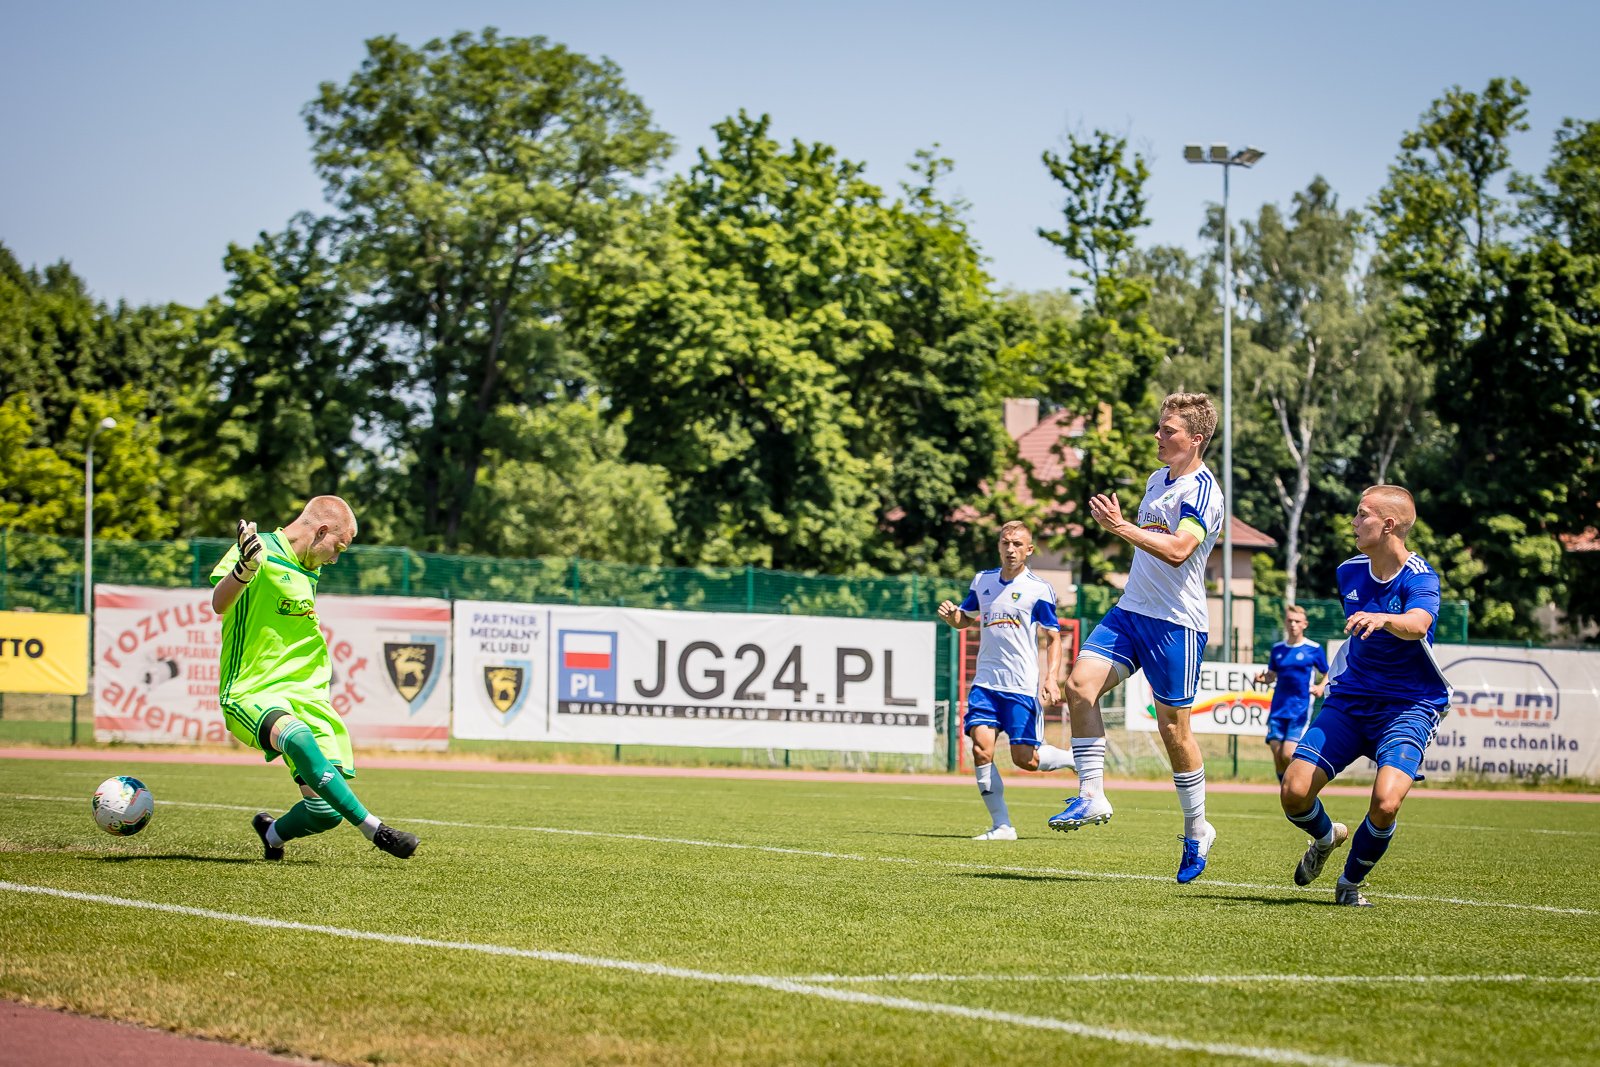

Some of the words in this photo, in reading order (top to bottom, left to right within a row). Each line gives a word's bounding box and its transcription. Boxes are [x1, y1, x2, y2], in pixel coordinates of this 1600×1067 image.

[473, 613, 537, 626] PARTNER
[103, 601, 222, 668] rozrus
[470, 626, 541, 641] MEDIALNY
[0, 638, 44, 658] TTO
[480, 641, 530, 653] KLUBU
[187, 665, 221, 681] JELE
[633, 639, 918, 706] JG24.PL
[1201, 671, 1269, 692] ELEN
[570, 673, 605, 698] PL
[332, 683, 365, 716] et
[102, 681, 226, 741] alterna
[568, 702, 675, 717] WIRTUALNE
[684, 706, 769, 720] CENTRUM
[779, 709, 863, 723] JELENIEJ
[1213, 698, 1268, 726] GÓR
[1483, 734, 1579, 750] mechanika
